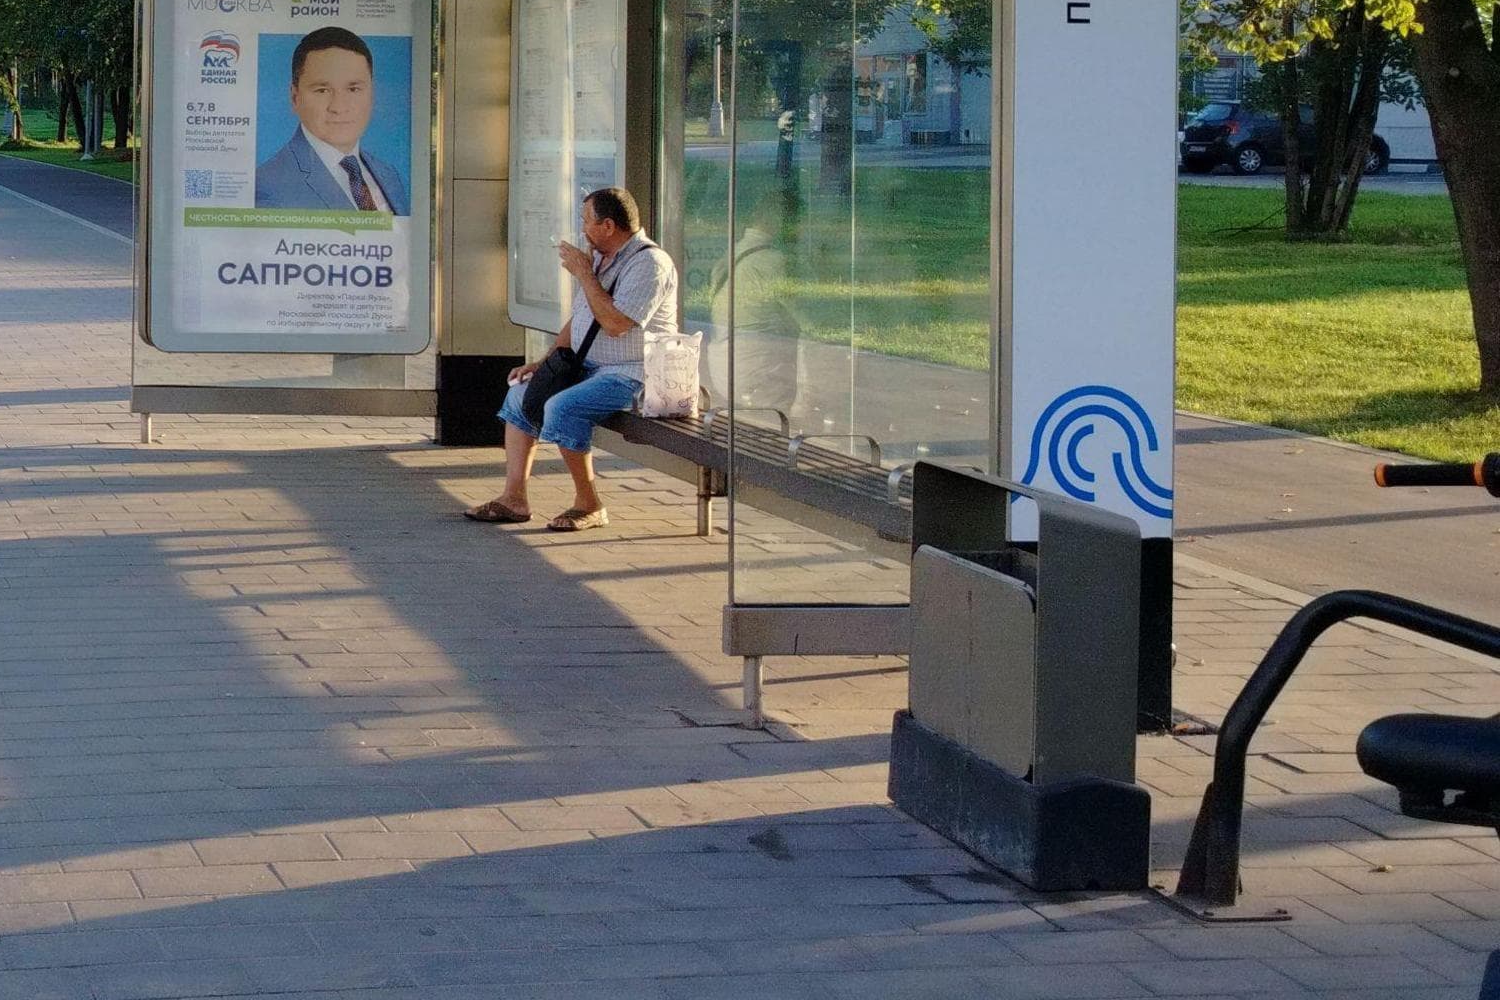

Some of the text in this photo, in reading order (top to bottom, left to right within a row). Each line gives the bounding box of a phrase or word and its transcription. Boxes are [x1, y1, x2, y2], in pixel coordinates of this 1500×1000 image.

[201, 69, 237, 77] ЕДИНАЯ
[201, 77, 237, 85] РОССИЯ
[186, 116, 250, 126] СЕНТЯБРЯ
[275, 238, 393, 262] Александр
[217, 262, 394, 288] САПРОНОВ
